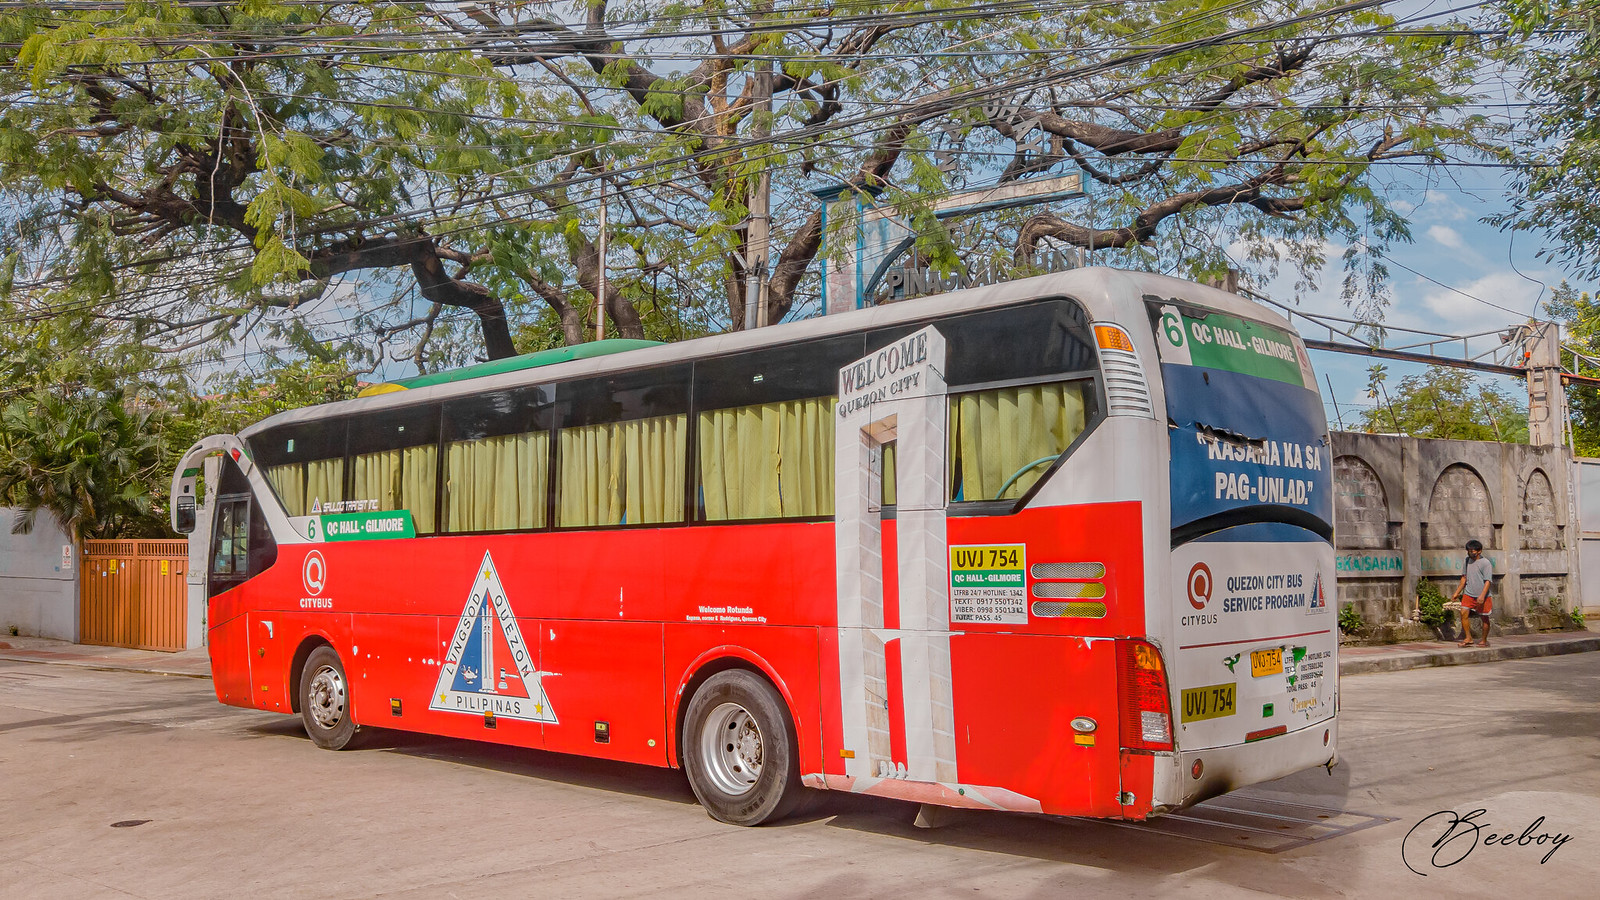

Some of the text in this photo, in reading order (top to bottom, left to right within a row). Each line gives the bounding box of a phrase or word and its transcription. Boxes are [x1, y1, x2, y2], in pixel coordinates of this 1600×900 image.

[1162, 312, 1184, 347] 6
[1191, 322, 1213, 345] QC
[1213, 326, 1247, 350] HALL
[1251, 336, 1296, 363] GILMORE
[841, 332, 928, 396] WELCOME
[839, 372, 921, 418] QUEZON CITY
[1283, 442, 1303, 469] KA
[1305, 445, 1322, 471] SA
[308, 519, 316, 539] 6
[327, 522, 338, 536] QC
[339, 520, 360, 534] HALL
[365, 518, 404, 533] GILMORE
[956, 549, 1018, 568] UVJ 754
[954, 574, 964, 583] QC
[966, 574, 984, 582] HALL
[988, 574, 1021, 582] GILMORE
[1227, 574, 1303, 593] QUEZON CITY BUS
[300, 598, 332, 608] CITYBUS
[699, 605, 753, 614] Welcome Rotunda
[1223, 594, 1305, 613] SERVICE PROGRAM
[1181, 614, 1218, 626] CITYBUS
[446, 593, 481, 676] LUNGSOD
[494, 595, 531, 679] QUEZON
[456, 695, 521, 714] PILIPINAS
[1186, 687, 1232, 717] UVJ 754
